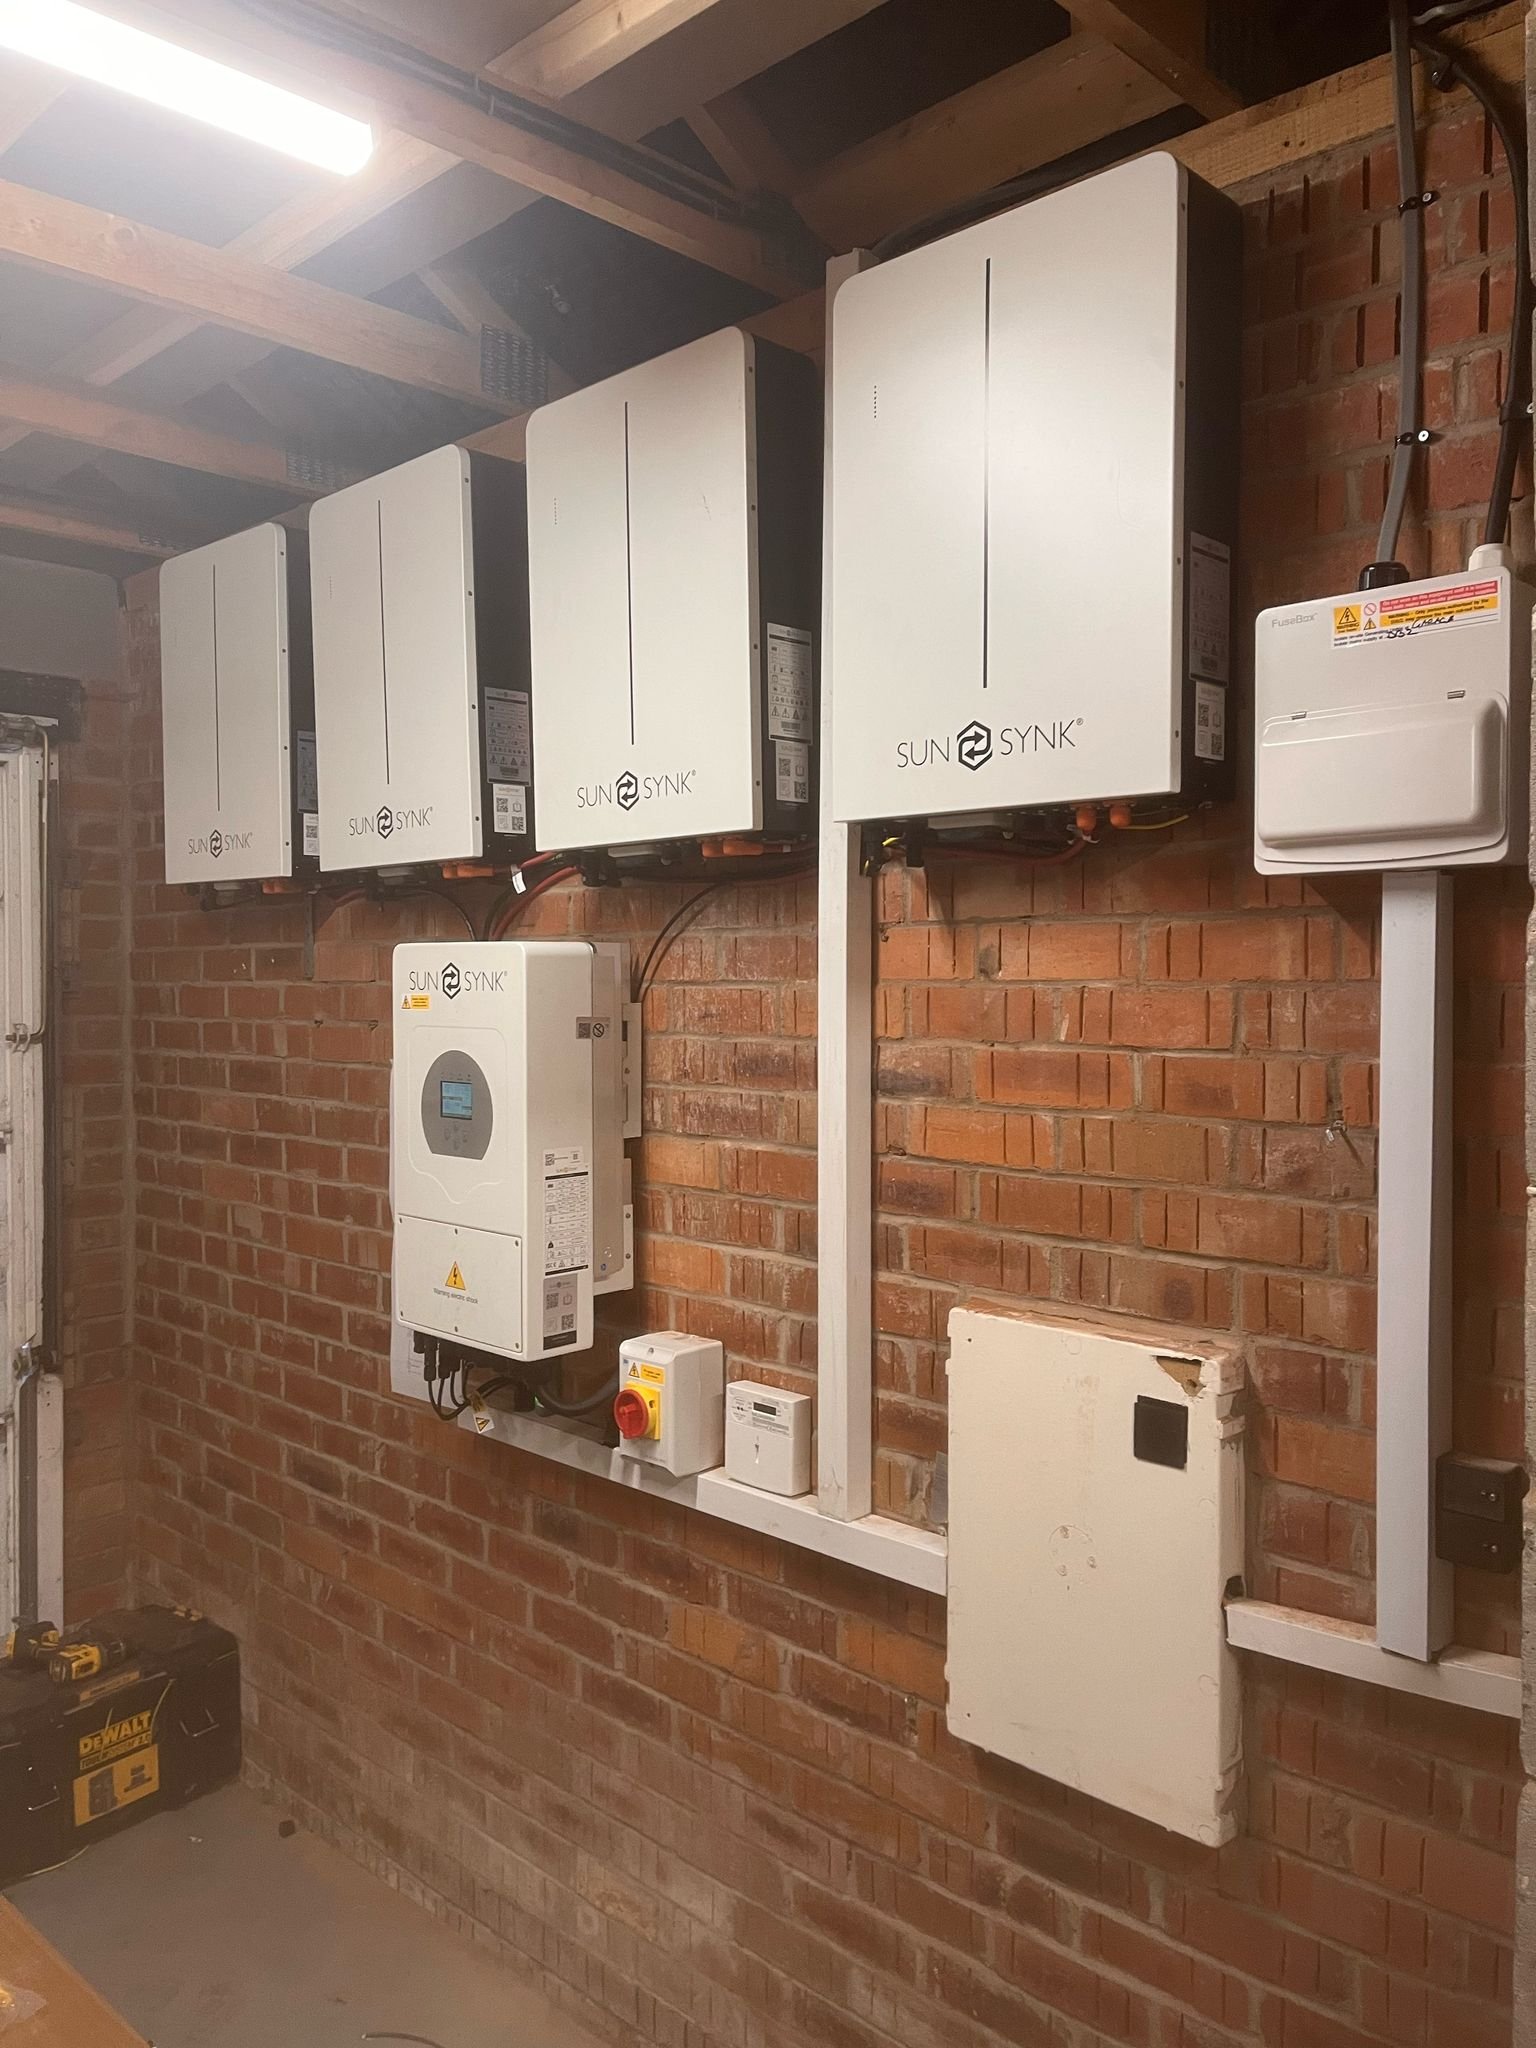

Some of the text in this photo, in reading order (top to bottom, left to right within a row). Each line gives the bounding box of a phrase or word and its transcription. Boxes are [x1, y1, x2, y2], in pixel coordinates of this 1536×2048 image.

[896, 736, 950, 768] SUN
[576, 783, 612, 808] SUN
[349, 815, 375, 836] SUN
[187, 837, 208, 855] SUN
[409, 970, 439, 991] SUN
